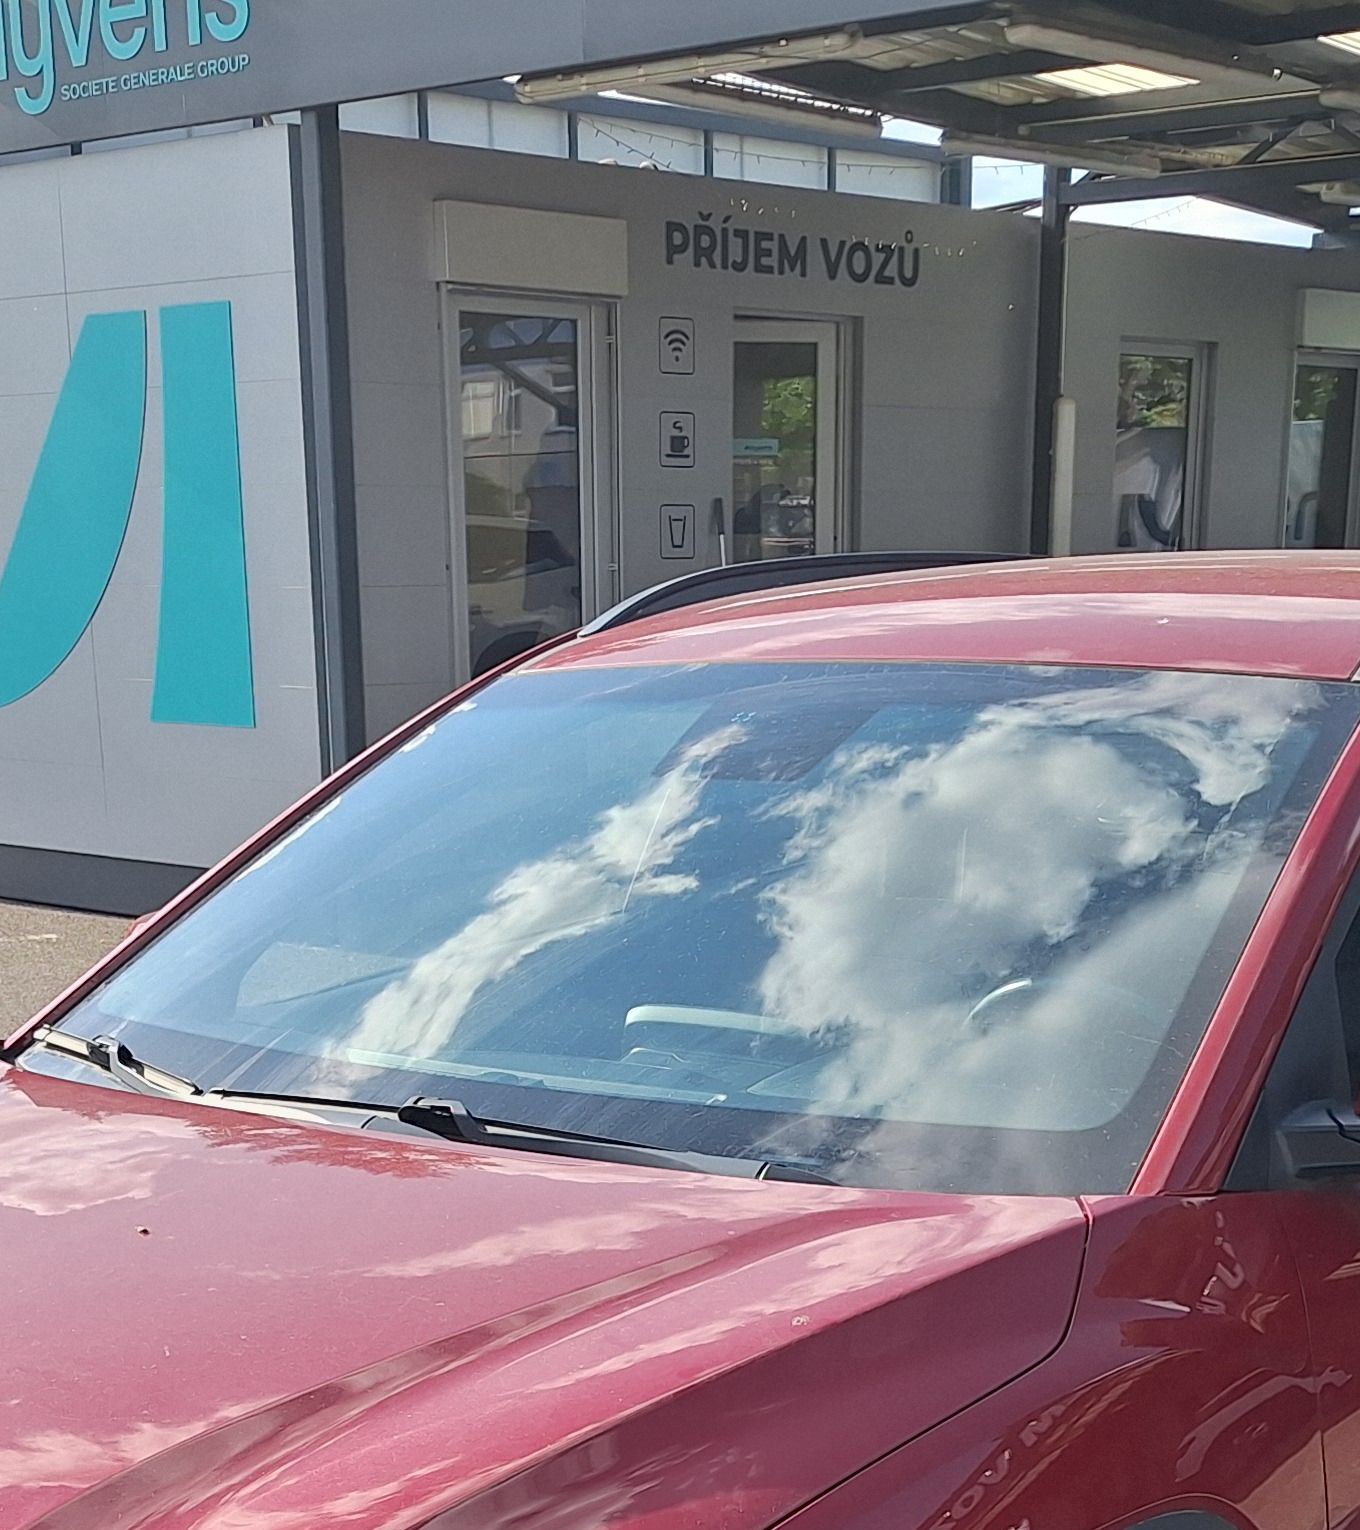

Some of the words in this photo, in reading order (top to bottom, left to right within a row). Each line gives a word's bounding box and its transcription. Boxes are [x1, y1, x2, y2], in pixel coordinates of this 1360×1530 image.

[60, 76, 118, 101] SOCIETE
[120, 62, 195, 91] GENERALE
[197, 54, 250, 78] GROUP
[664, 210, 808, 279] PŘÍJEM
[818, 229, 921, 288] VOZŮ
